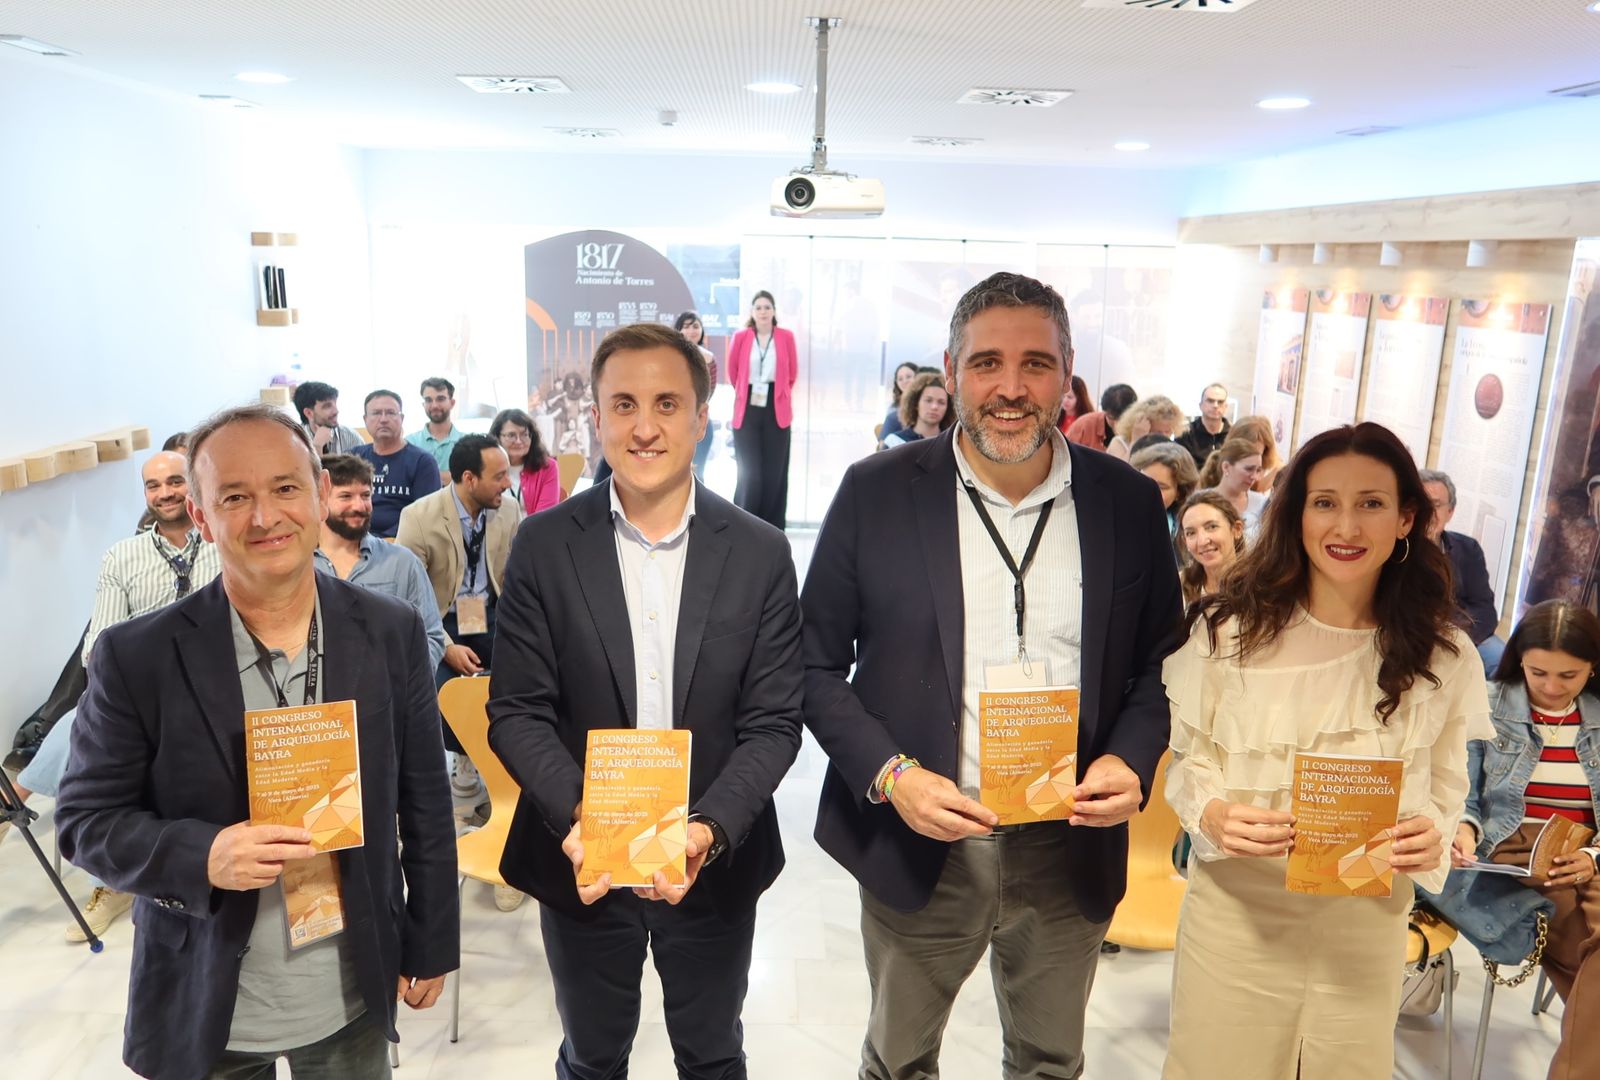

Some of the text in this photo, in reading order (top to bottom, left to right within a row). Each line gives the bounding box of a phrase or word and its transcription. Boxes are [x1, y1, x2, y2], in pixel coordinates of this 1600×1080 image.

[576, 243, 624, 269] 1817
[576, 277, 654, 286] Antonio de Torres
[986, 696, 1048, 705] II CONGRESO
[986, 705, 1067, 716] INTERNACIONAL
[252, 710, 322, 726] II CONGRESO
[986, 714, 1072, 727] DE ARQUEOLOGÍA
[252, 719, 343, 738] INTERNACIONAL
[986, 728, 1020, 737] BAYRA
[253, 730, 351, 750] DE ARQUEOLOGÍA
[593, 735, 658, 744] II CONGRESO
[254, 750, 292, 761] BAYRA
[592, 747, 676, 756] INTERNACIONAL
[592, 758, 683, 769] DE ARQUEOLOGÍA
[1312, 762, 1371, 772] CONGRESO
[591, 771, 624, 780] BAYRA
[1301, 771, 1390, 784] INTERNACIONAL
[1300, 782, 1395, 795] DE ARQUEOLOGÍA
[1300, 793, 1336, 804] BAYRA
